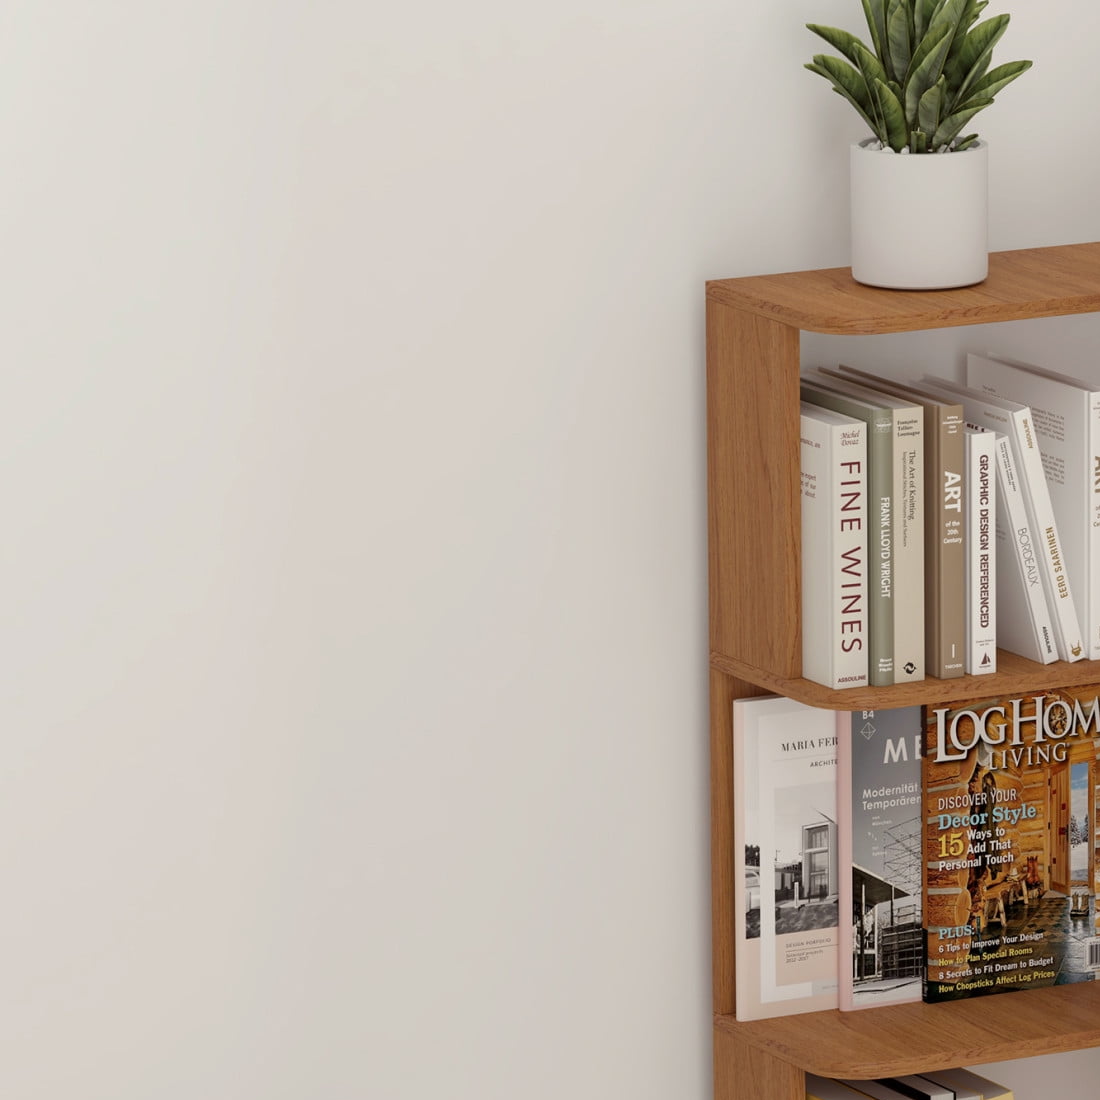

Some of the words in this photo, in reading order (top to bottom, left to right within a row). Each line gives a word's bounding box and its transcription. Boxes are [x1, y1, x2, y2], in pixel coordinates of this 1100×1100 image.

[945, 471, 961, 512] ART
[980, 455, 989, 505] GRAPHIC
[840, 461, 861, 532] FINE
[880, 497, 891, 527] FRANK
[980, 509, 989, 550] DESIGN
[880, 529, 891, 559] LLOYD
[1046, 527, 1064, 572] SAARINEN
[1018, 528, 1038, 587] BORDEAUX
[880, 562, 891, 598] WRIGHT
[980, 554, 989, 628] REFERENCED
[1056, 575, 1068, 598] EERO
[841, 546, 862, 652] WINES
[838, 675, 866, 684] ASSOULINE
[781, 740, 815, 752] MARIA
[989, 742, 1067, 770] LIVING
[863, 783, 918, 798] Modernität
[938, 793, 987, 810] DISCOVER
[990, 788, 1016, 803] YOUR
[938, 812, 988, 830] Decor
[992, 804, 1036, 824] Style
[938, 833, 964, 857] 15
[967, 829, 992, 841] Ways
[996, 827, 1005, 836] to
[967, 842, 986, 854] Add
[990, 839, 1011, 851] That
[939, 856, 982, 871] Personal
[985, 852, 1014, 865] Touch
[938, 925, 975, 939] PLUS:
[946, 943, 960, 952] Tips
[972, 939, 1000, 949] Improve
[1002, 936, 1018, 944] Your
[1020, 932, 1044, 941] Design
[983, 949, 1007, 961] Special
[1009, 947, 1033, 957] Rooms
[946, 969, 972, 979] Secrets
[984, 965, 992, 974] Fit
[995, 963, 1017, 972] Dream
[1028, 957, 1054, 967] Budget
[956, 979, 994, 991] Chopsticks
[996, 976, 1016, 985] Affect
[1019, 974, 1031, 982] Log
[1033, 970, 1055, 980] Prices
